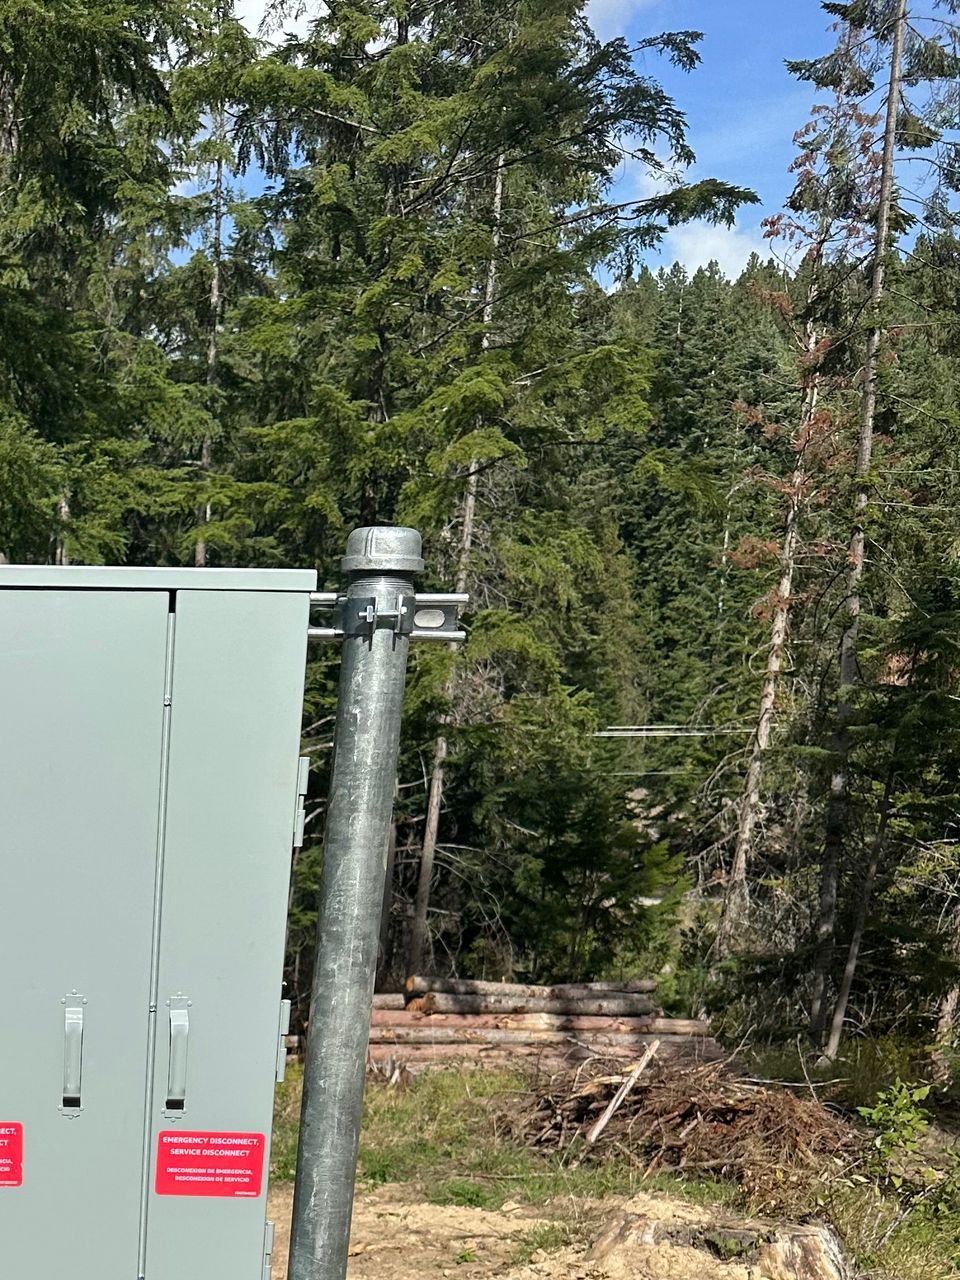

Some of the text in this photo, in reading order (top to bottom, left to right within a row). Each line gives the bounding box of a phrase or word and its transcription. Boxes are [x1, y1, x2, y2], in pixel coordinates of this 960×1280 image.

[162, 1136, 260, 1147] EMERGENCY DISCONNECT,
[169, 1148, 251, 1157] SERVICE DISCONNECT
